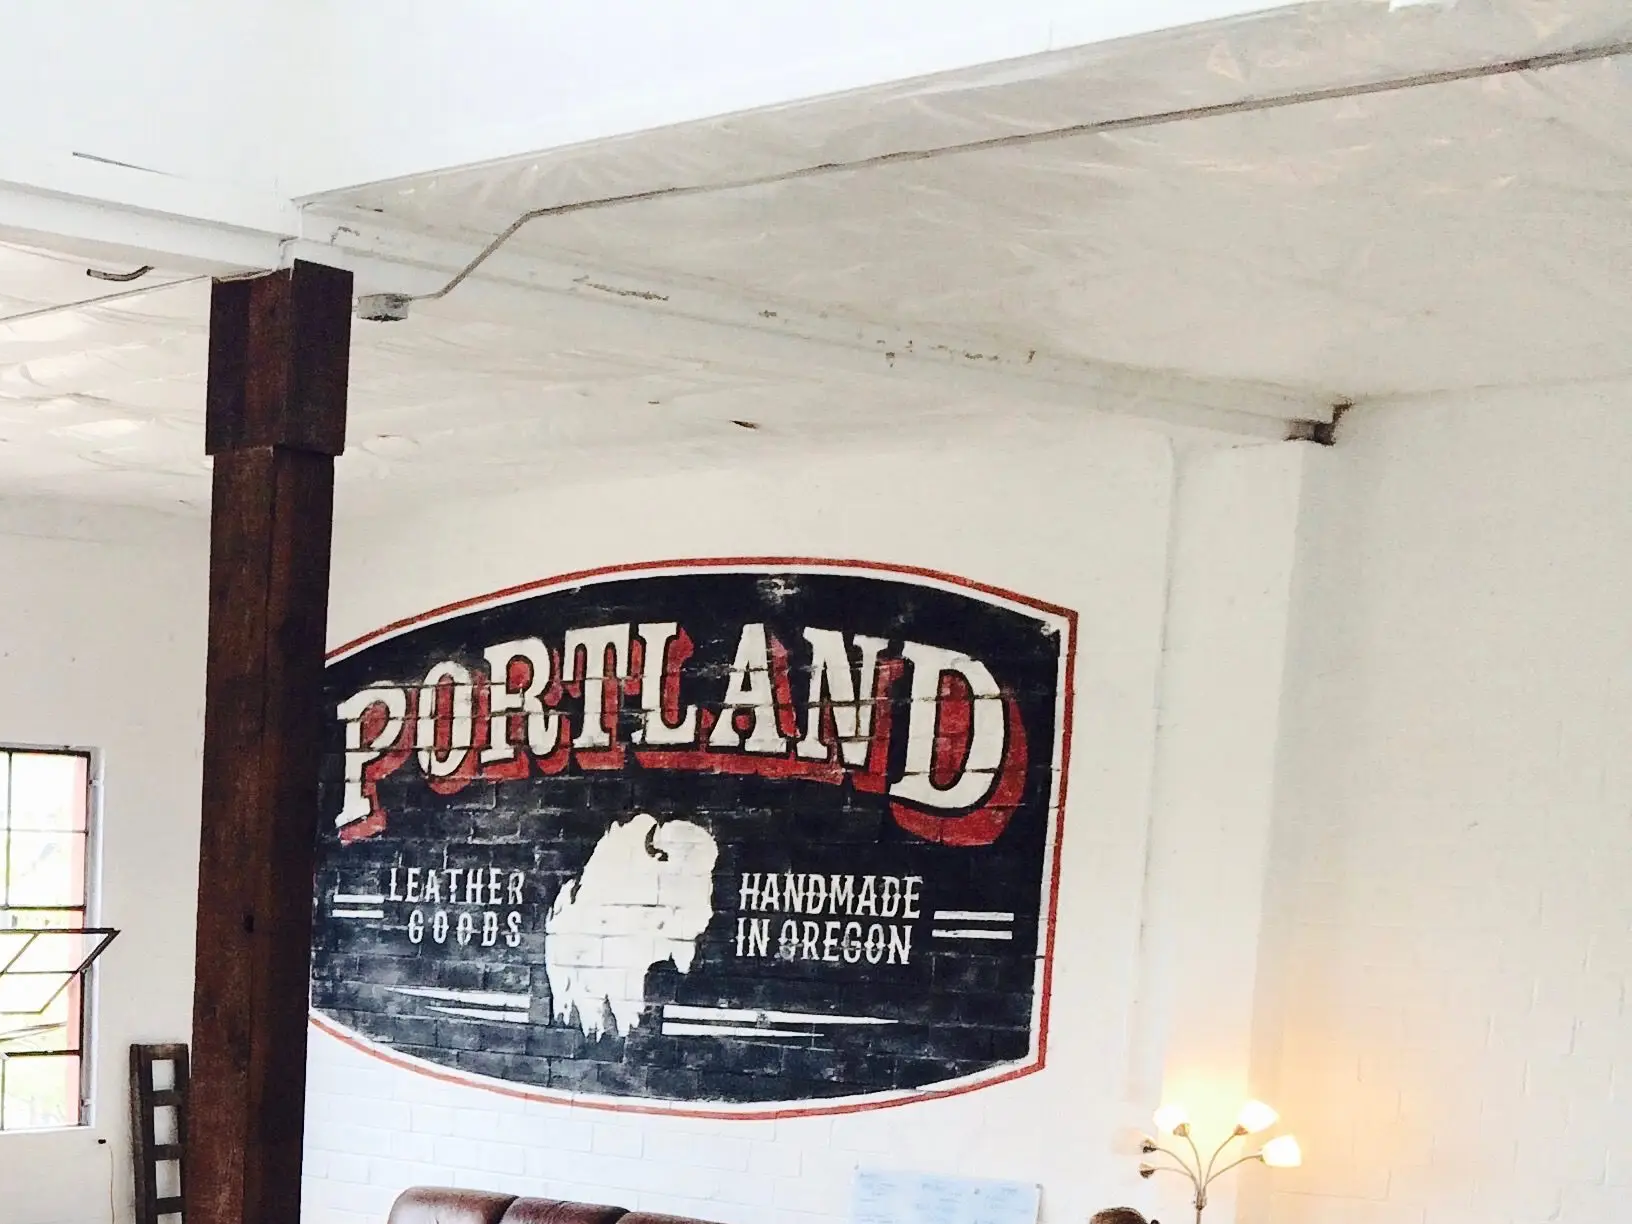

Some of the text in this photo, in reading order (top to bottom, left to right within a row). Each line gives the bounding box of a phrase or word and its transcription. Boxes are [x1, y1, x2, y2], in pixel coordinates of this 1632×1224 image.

[335, 621, 1010, 834] PORTLAND
[387, 867, 526, 907] LEATHER
[738, 871, 923, 920] HANDMADE
[408, 911, 523, 949] GOODS
[735, 917, 913, 966] IN OREGON
